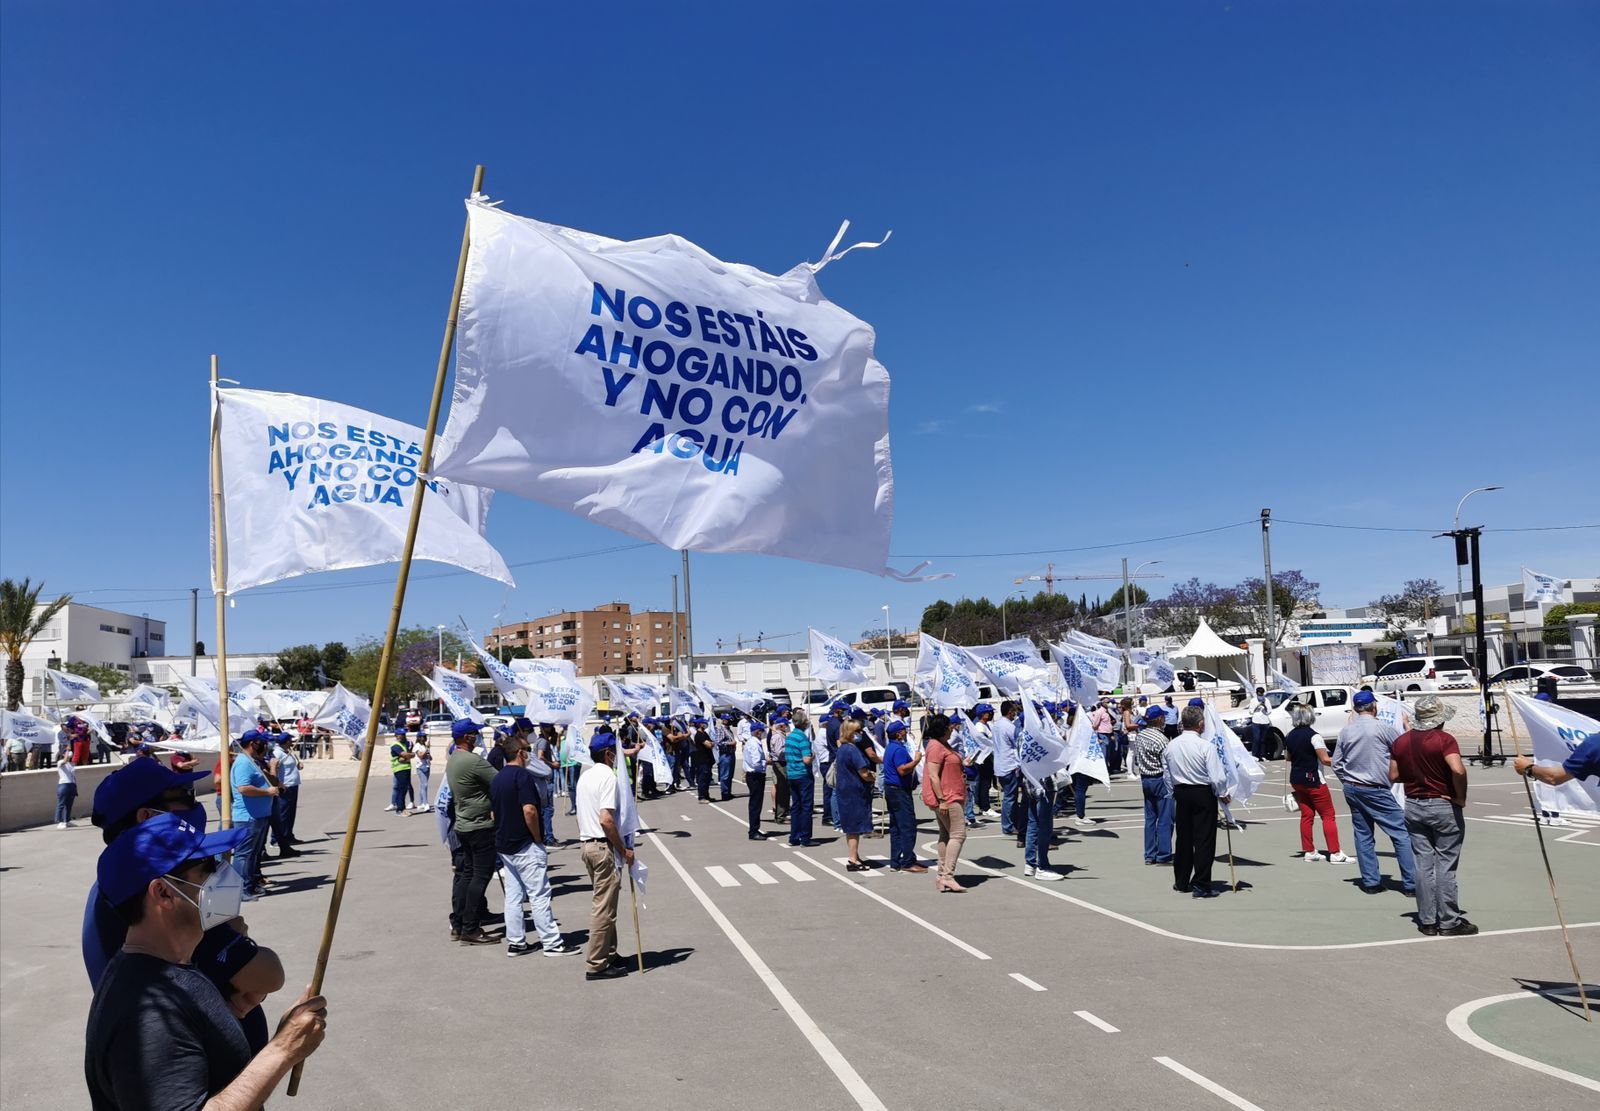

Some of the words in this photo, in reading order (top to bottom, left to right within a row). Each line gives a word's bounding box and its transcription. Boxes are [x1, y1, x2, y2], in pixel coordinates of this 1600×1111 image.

[591, 282, 692, 338] NOS
[696, 305, 818, 361] ESTÁIS
[602, 367, 635, 407] Y
[640, 379, 713, 424] NO
[722, 395, 797, 439] CON
[268, 422, 337, 446] NOS
[347, 424, 422, 456] ESTÁ
[631, 422, 744, 476] AGUA
[268, 444, 418, 474] AHOGAND
[283, 466, 303, 491] Y
[308, 462, 357, 485] NO
[307, 483, 404, 510] AGUA
[1557, 726, 1589, 740] NO
